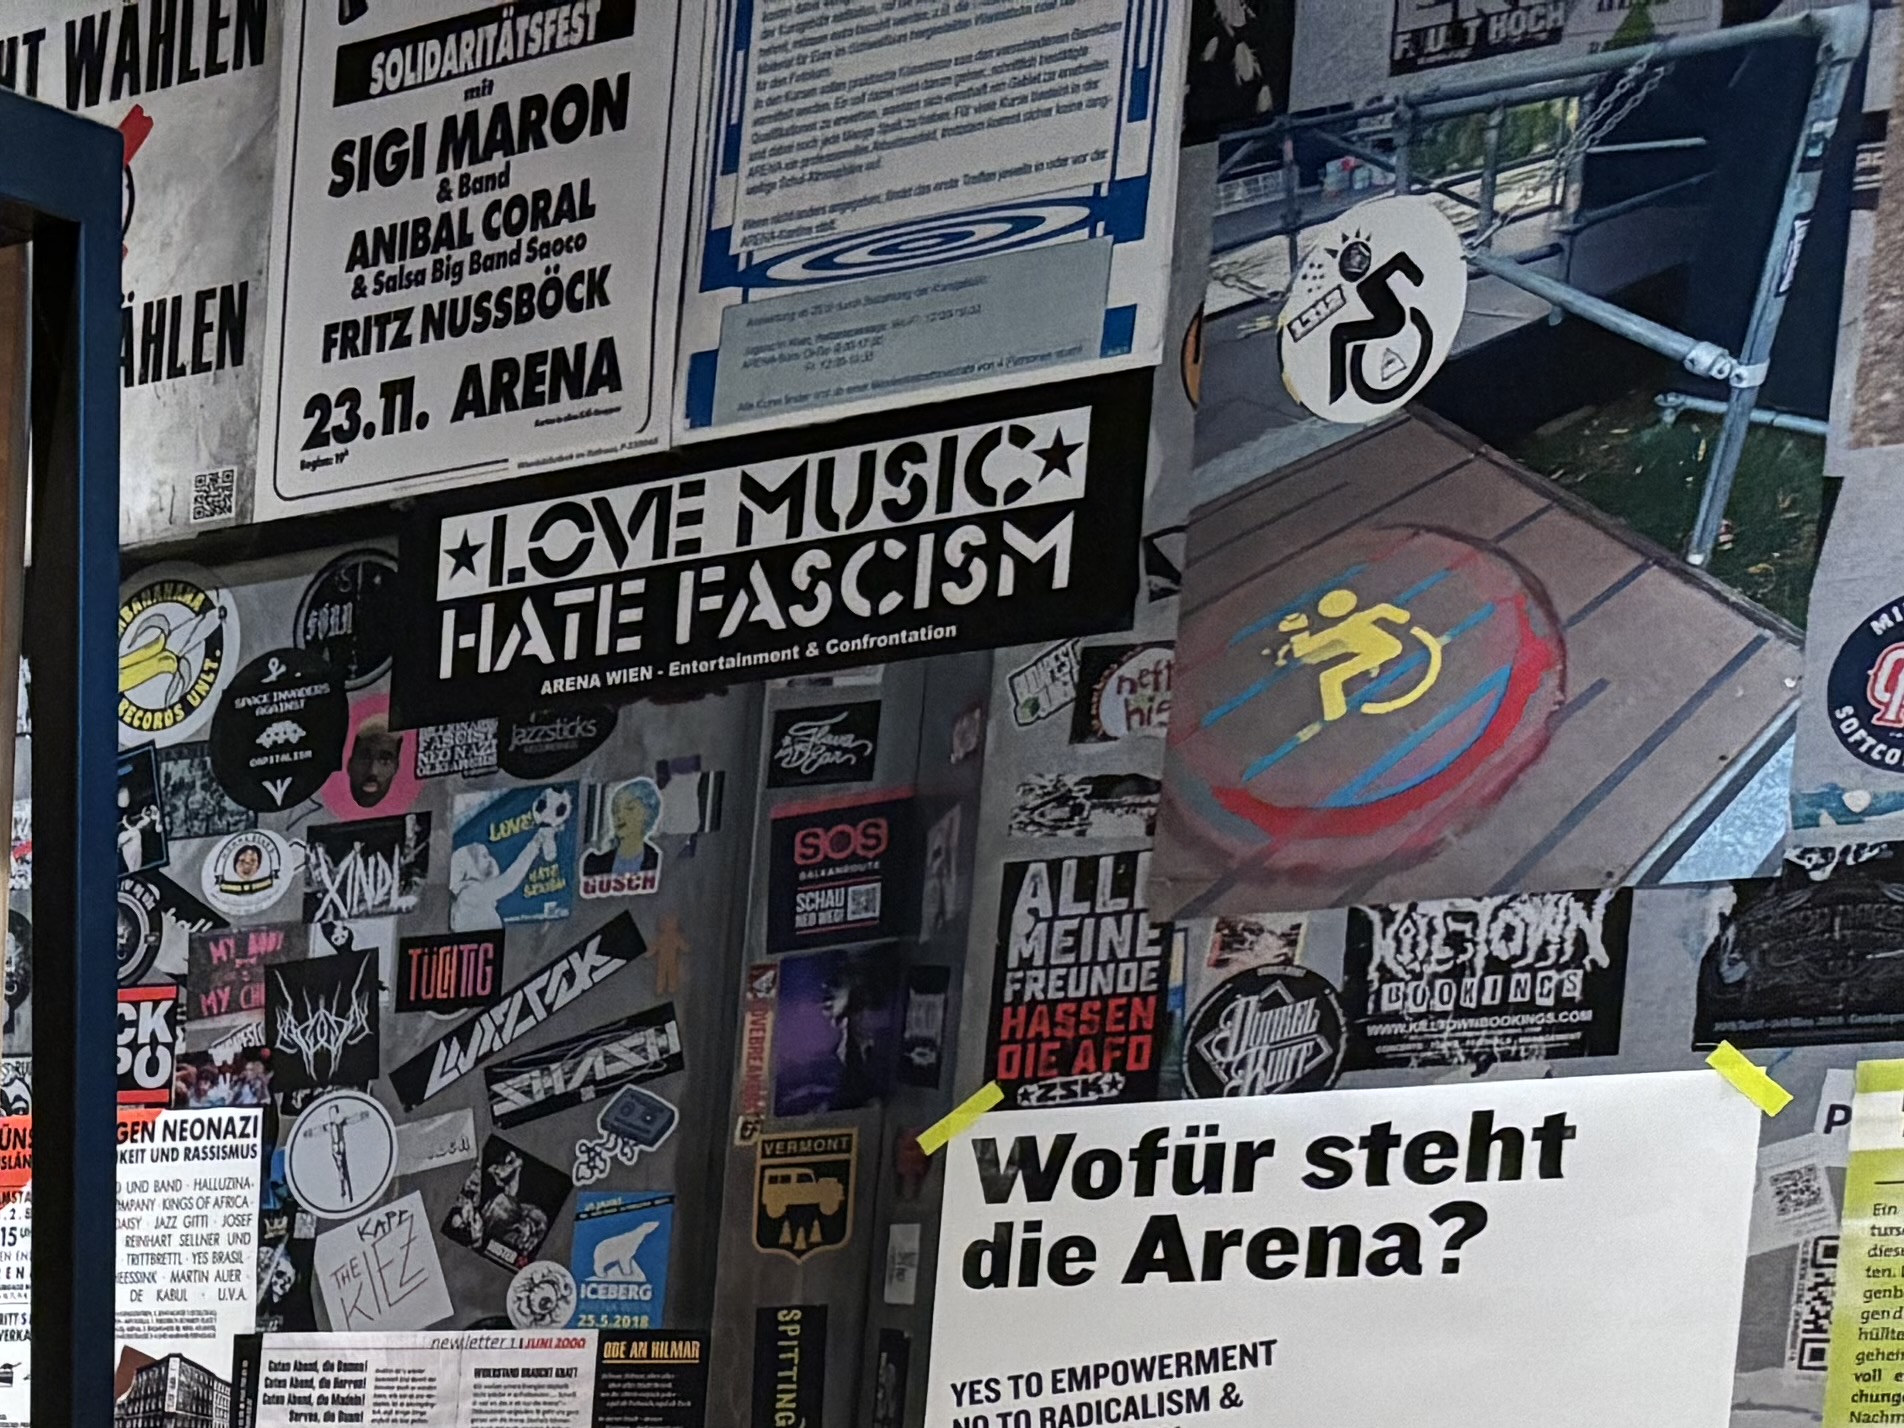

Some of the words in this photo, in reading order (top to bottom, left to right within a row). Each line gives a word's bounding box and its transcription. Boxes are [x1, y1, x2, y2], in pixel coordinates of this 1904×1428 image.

[369, 3, 600, 96] SOLIDARITÄTSFEST
[464, 78, 494, 102] mit
[327, 121, 427, 199] SIGI
[436, 72, 631, 175] MARON
[436, 178, 454, 204] &
[458, 161, 511, 198] Band
[345, 206, 474, 274] ANIBAL
[482, 177, 597, 242] CORAL
[350, 274, 367, 300] &
[372, 265, 426, 297] Salsa
[430, 254, 464, 286] Big
[468, 238, 522, 276] Band
[525, 232, 587, 263] Saoco
[322, 306, 416, 364] FRITZ
[419, 263, 611, 345] NUSSBÖCK
[300, 376, 429, 452] 23.11.
[450, 335, 623, 424] ARENA
[488, 478, 706, 588] LOVE
[736, 424, 1038, 548] MUSIC
[438, 578, 646, 680] HATE
[676, 510, 1075, 645] FASCISM
[540, 671, 601, 695] ARENA
[603, 665, 653, 687] WIEN
[669, 643, 800, 678] Entertainment
[806, 640, 819, 657] &
[825, 623, 958, 654] Confrontation
[794, 817, 889, 865] SOS
[796, 887, 844, 913] SCHAU
[1008, 911, 1162, 968] MEINE
[1004, 961, 1160, 1003] FREUNDE
[1000, 996, 1157, 1041] HASSEN
[998, 1041, 1060, 1080] DIE
[150, 1146, 179, 1162] UND
[183, 1144, 257, 1161] RASSISMUS
[162, 1115, 258, 1142] NEONAZI
[764, 1137, 849, 1155] VERMONT
[972, 1124, 1275, 1205] Wofür
[1302, 1110, 1577, 1190] steht
[962, 1220, 1097, 1289] die
[1121, 1200, 1489, 1284] Arena?
[580, 1283, 652, 1300] ICEBERG
[578, 1314, 649, 1328] 25.5.2018
[629, 1341, 648, 1358] AN
[651, 1341, 700, 1358] HILMAR
[774, 1309, 802, 1427] SPITTING
[950, 1378, 1001, 1407] YES
[1008, 1372, 1043, 1400] TO
[1051, 1339, 1278, 1394] EMPOWERMENT
[1219, 1382, 1243, 1409] &
